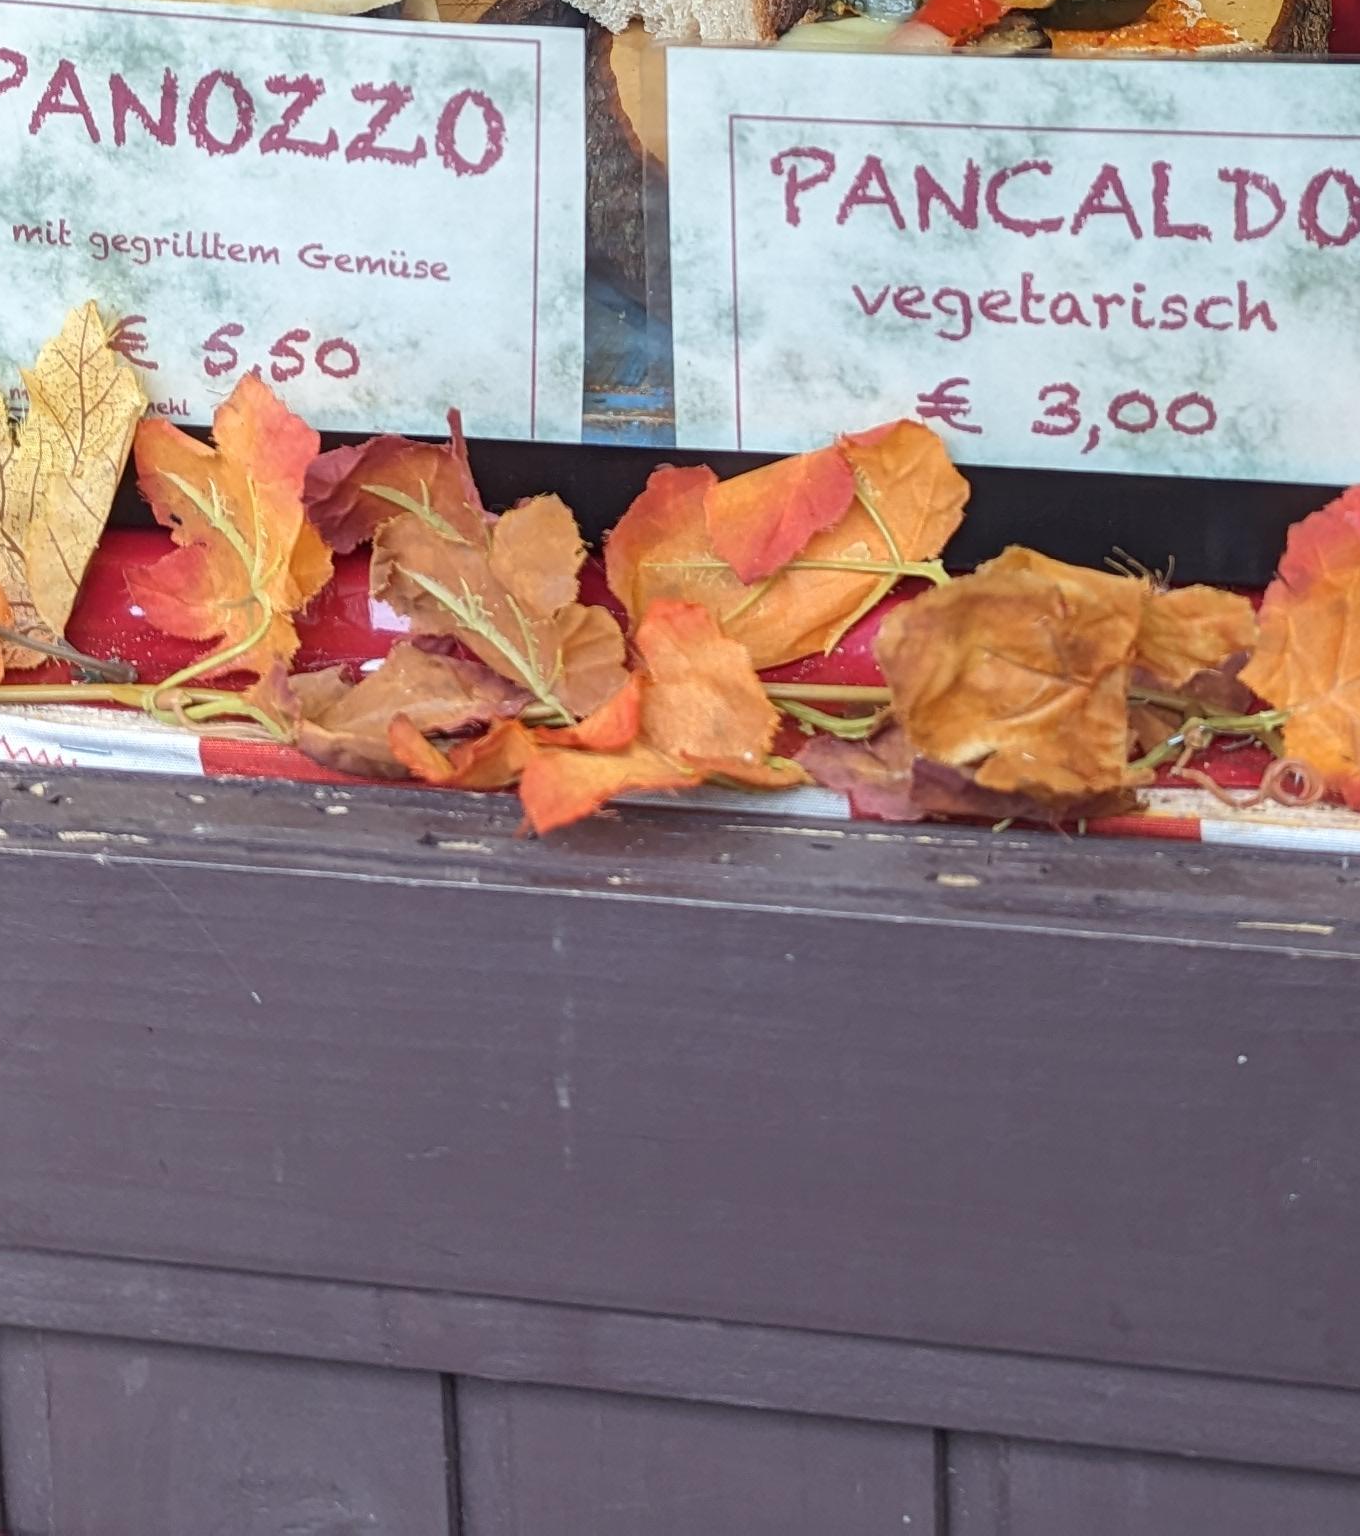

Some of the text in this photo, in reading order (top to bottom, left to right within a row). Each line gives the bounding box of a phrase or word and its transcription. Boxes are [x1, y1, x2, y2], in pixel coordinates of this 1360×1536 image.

[11, 218, 452, 282] mit gegrilltem Gemüse
[851, 271, 1278, 341] vegetarisch
[106, 314, 159, 370] €
[915, 377, 1218, 455] € 3,00
